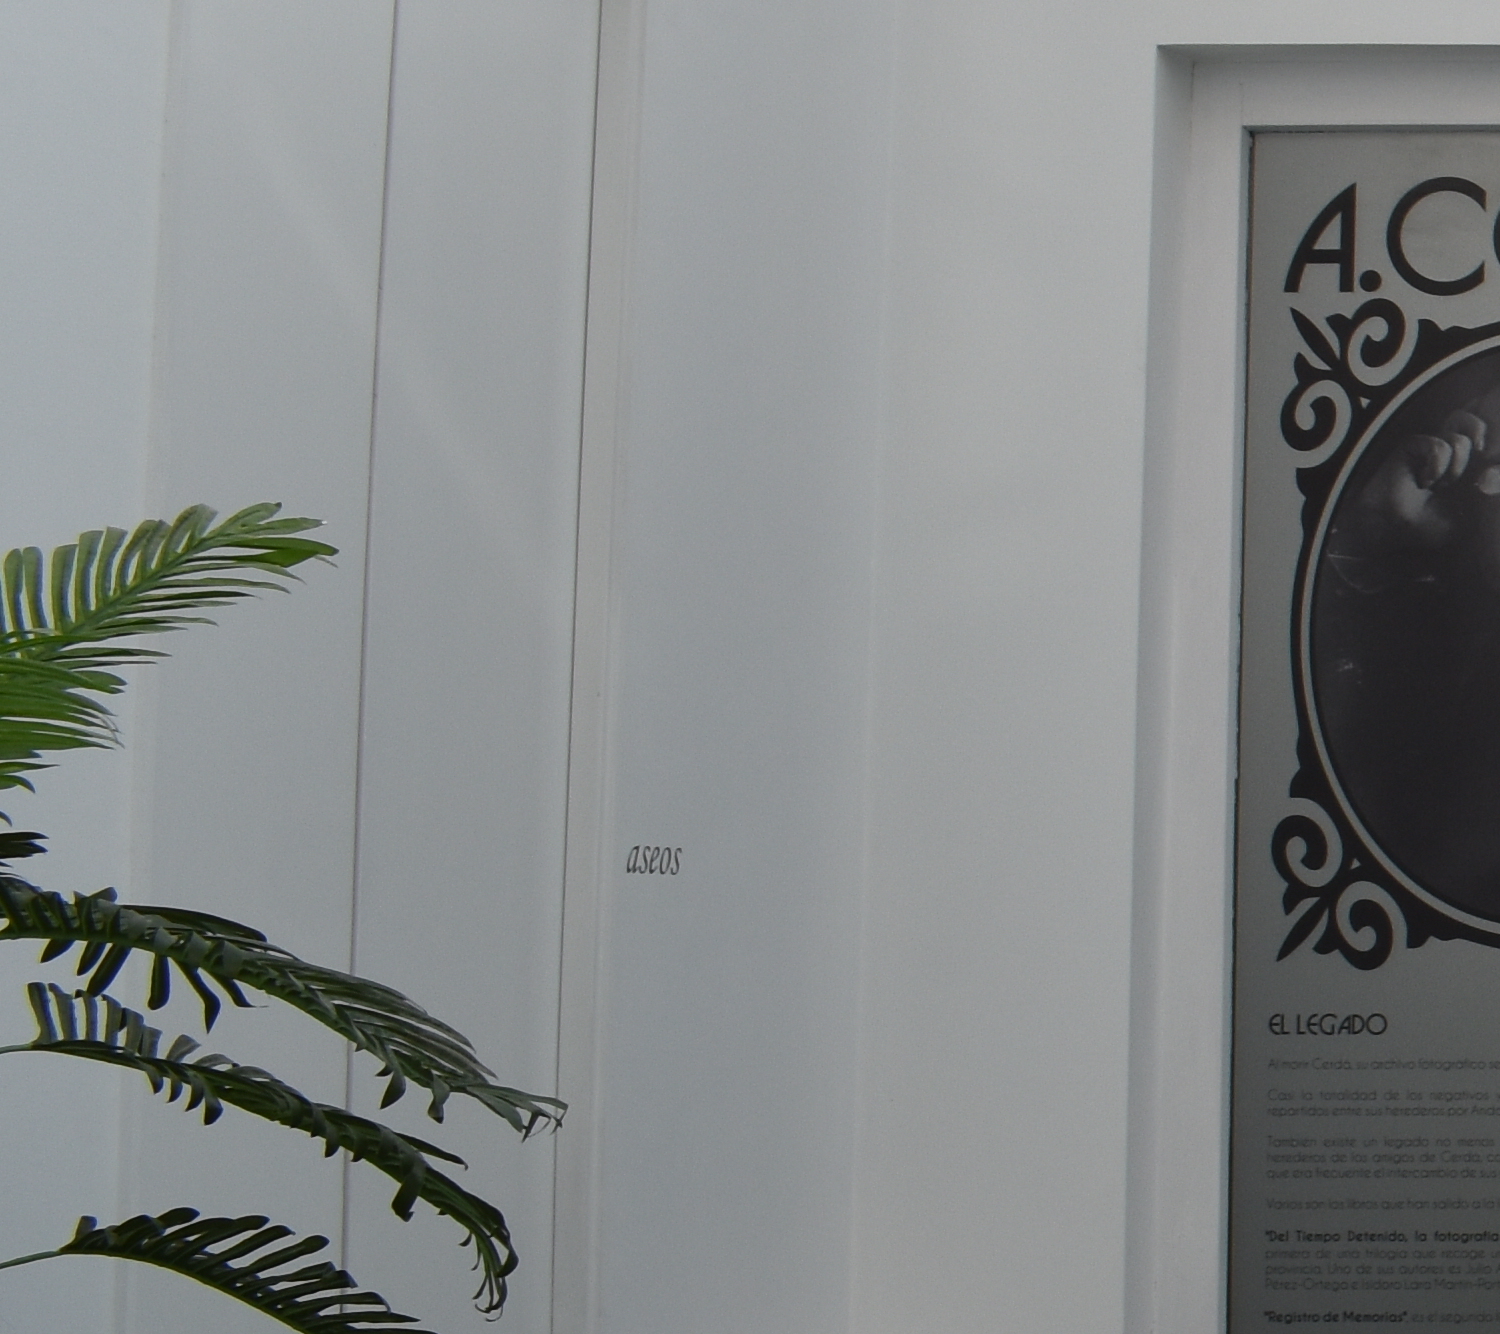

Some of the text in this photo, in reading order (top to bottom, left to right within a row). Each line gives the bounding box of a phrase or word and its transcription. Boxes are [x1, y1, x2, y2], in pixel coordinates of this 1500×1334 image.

[626, 845, 683, 876] aseos
[1268, 1013, 1388, 1036] EL LEGADO
[1413, 1229, 1428, 1243] la
[1321, 1310, 1340, 1324] de
